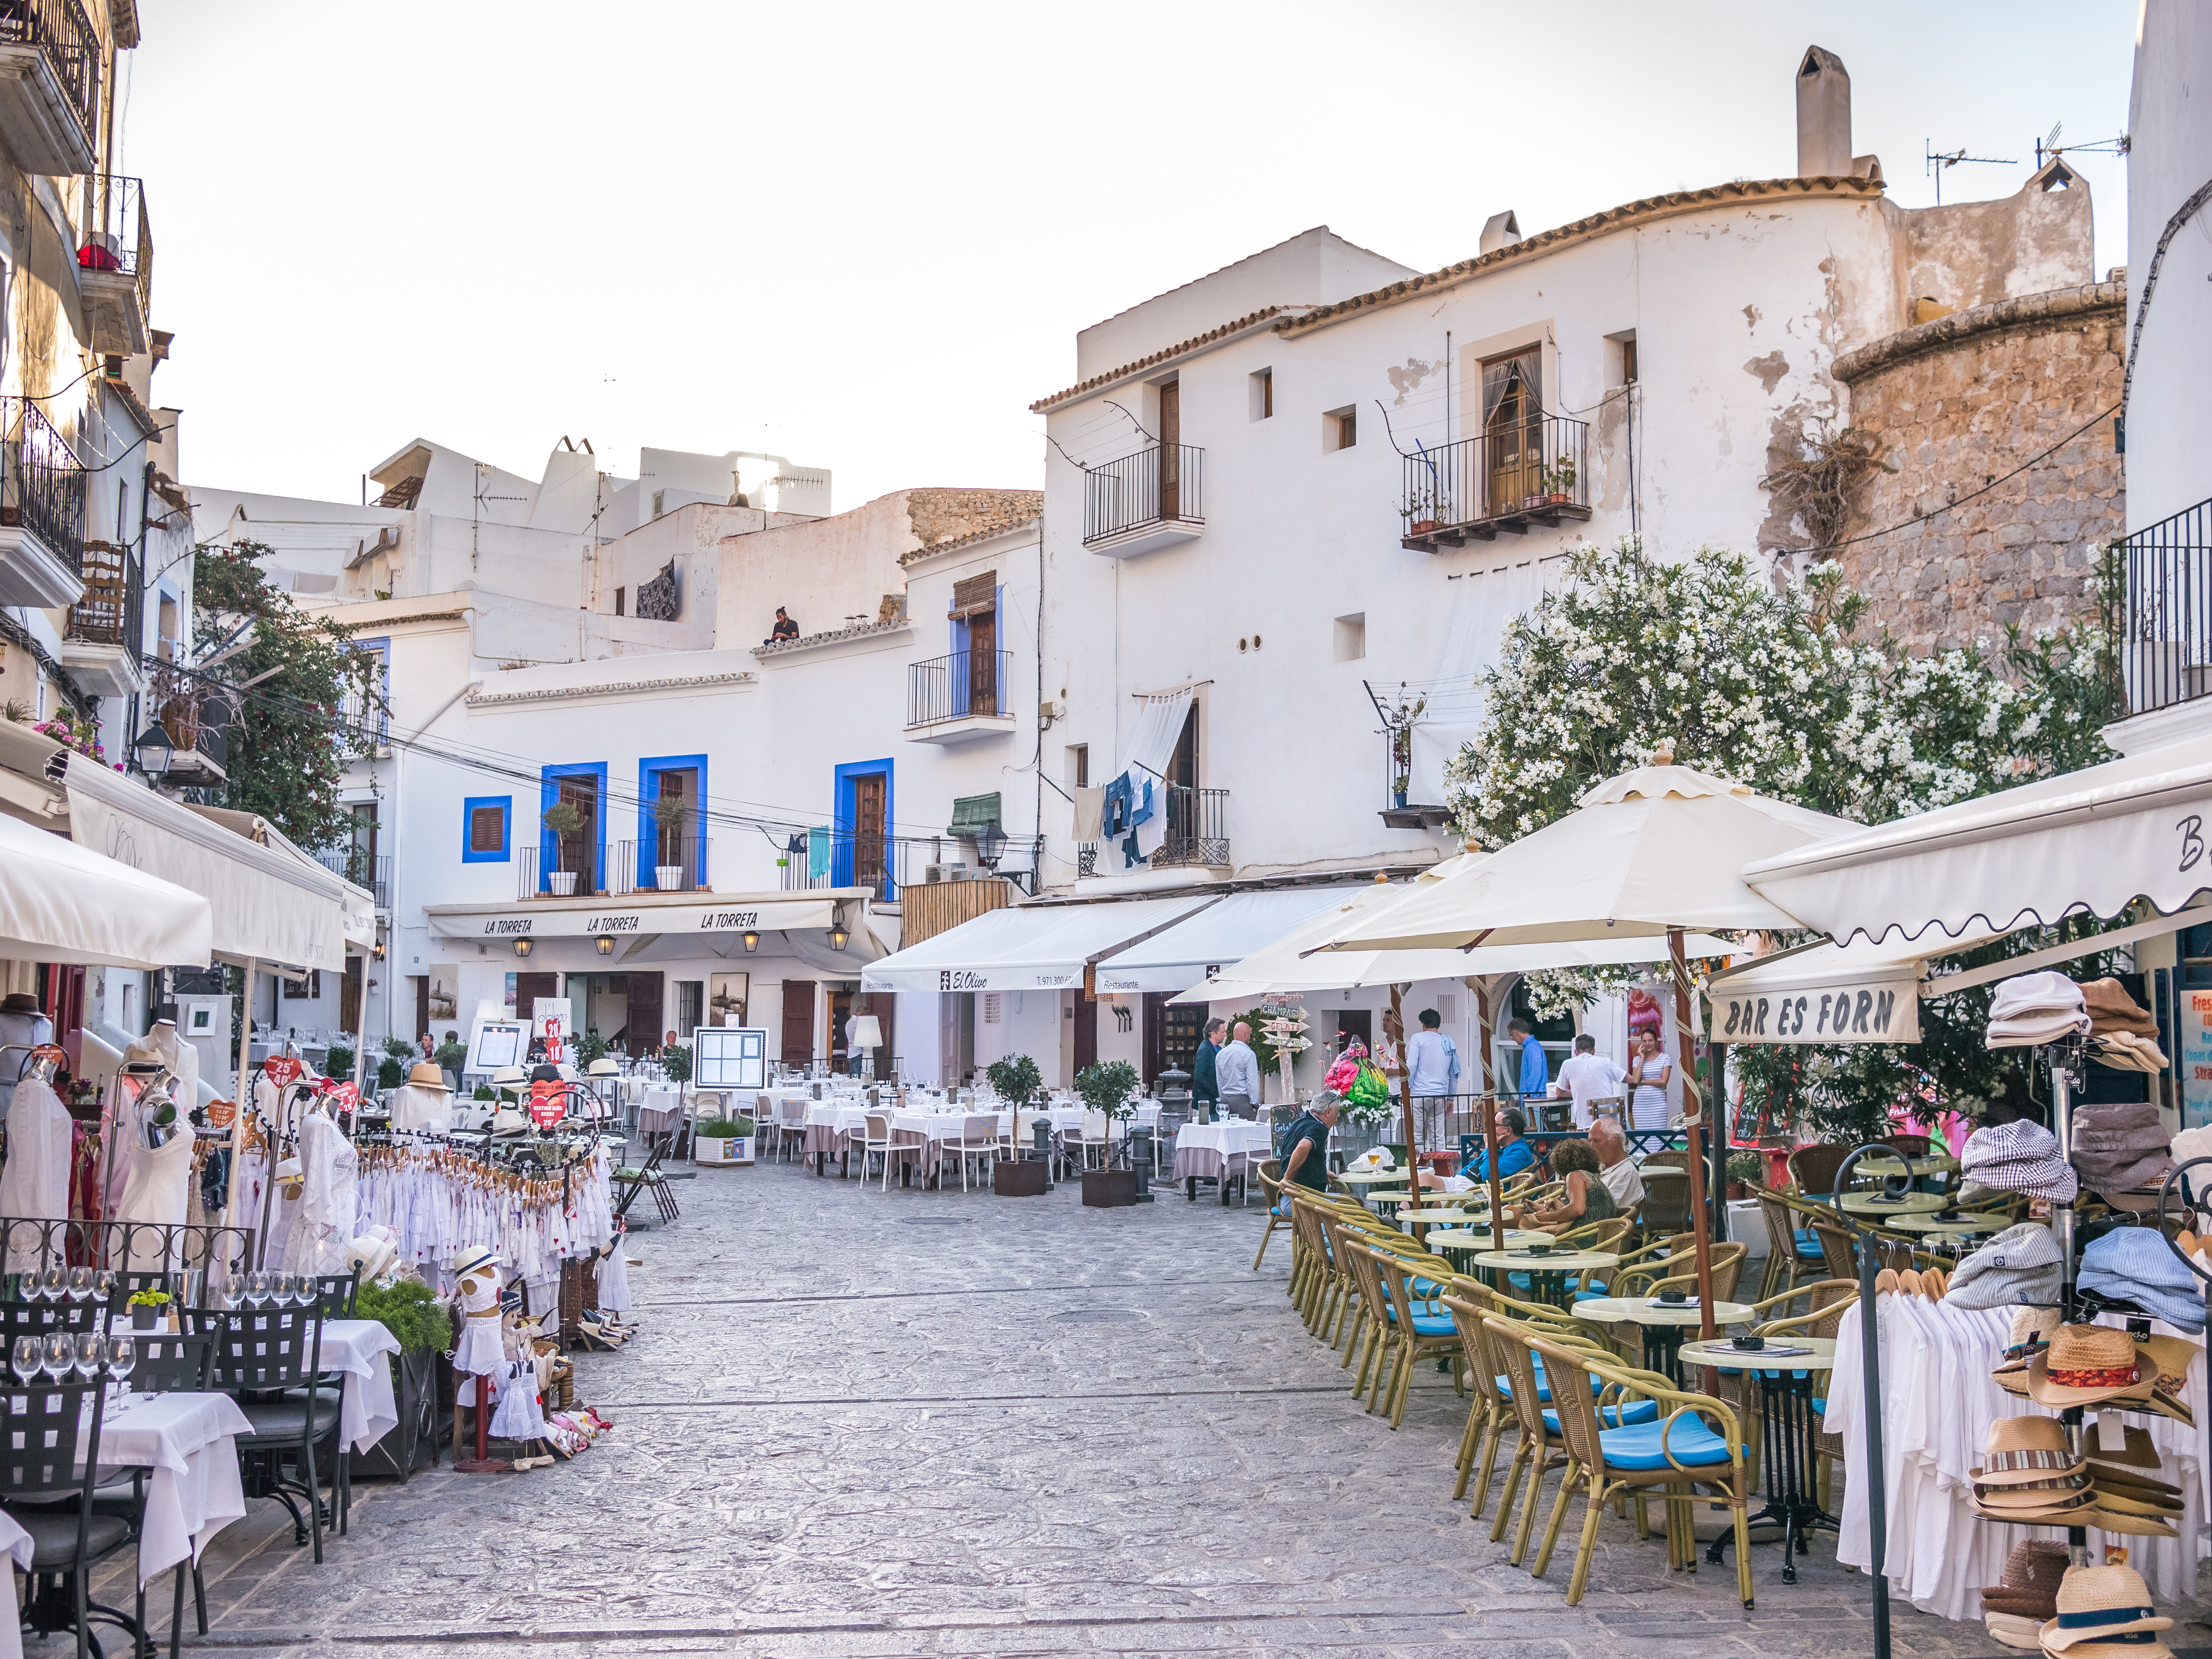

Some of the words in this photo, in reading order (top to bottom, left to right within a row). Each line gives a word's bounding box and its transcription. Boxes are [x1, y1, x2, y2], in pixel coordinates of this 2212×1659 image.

[2176, 815, 2212, 872] B
[485, 921, 495, 934] LA
[497, 919, 532, 934] TORRETA
[588, 918, 599, 932] LA
[600, 916, 639, 931] TORRETA
[701, 914, 714, 929] LA
[716, 913, 757, 927] TORRETA
[297, 979, 317, 993] Olia
[867, 981, 893, 989] Restaurante
[953, 971, 964, 989] El
[965, 971, 987, 989] Olivo
[1042, 976, 1052, 986] 971
[1054, 976, 1064, 985] 300
[1104, 980, 1139, 989] Restaurante
[1262, 1005, 1305, 1019] CHAMPAGNE
[1724, 998, 1769, 1036] BAR
[1778, 996, 1807, 1036] ES
[1816, 989, 1895, 1035] FORN
[1271, 1022, 1300, 1031] GELATO
